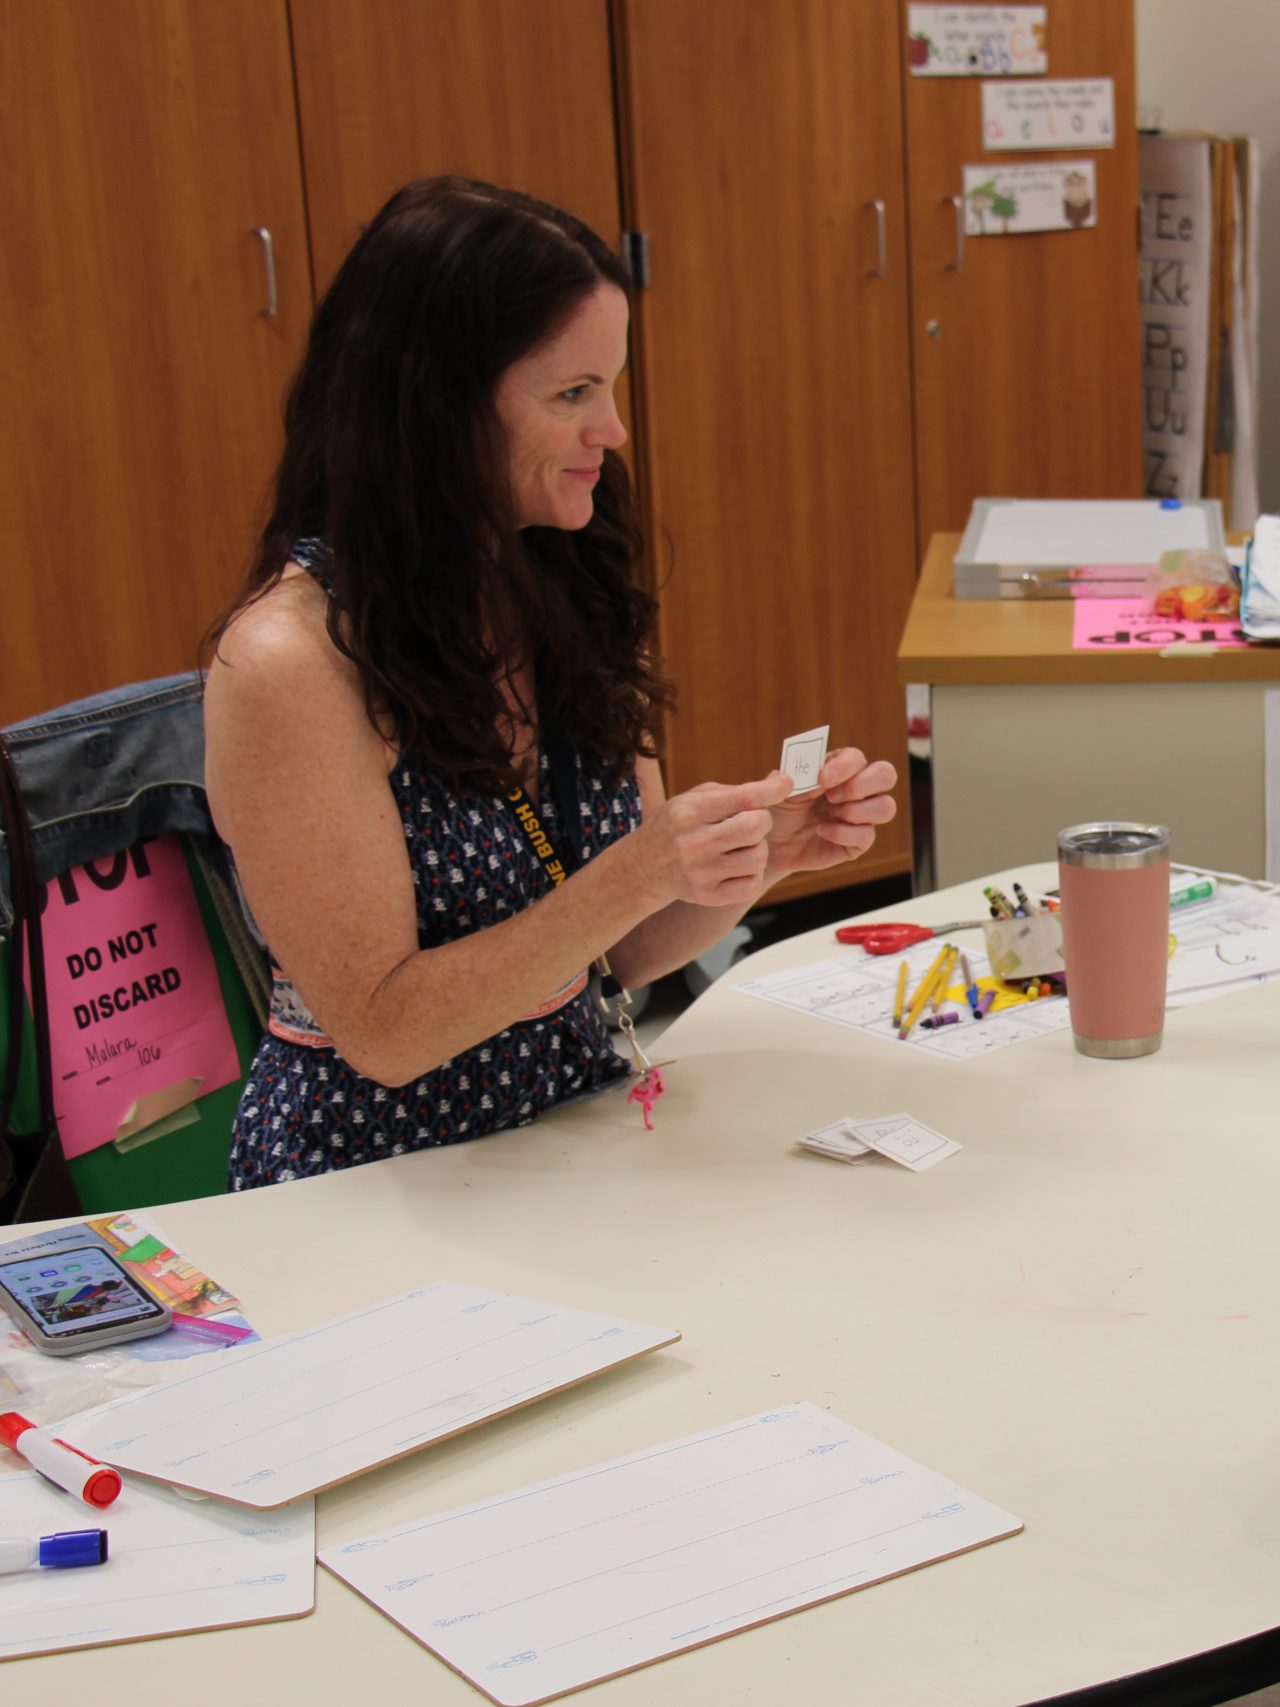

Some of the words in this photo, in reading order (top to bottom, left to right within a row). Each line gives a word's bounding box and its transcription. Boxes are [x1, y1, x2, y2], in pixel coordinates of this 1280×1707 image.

[515, 803, 554, 859] BUSH
[66, 946, 102, 980] DO
[107, 923, 158, 963] NOT
[73, 966, 182, 1030] DISCARD
[85, 1034, 139, 1069] Malara
